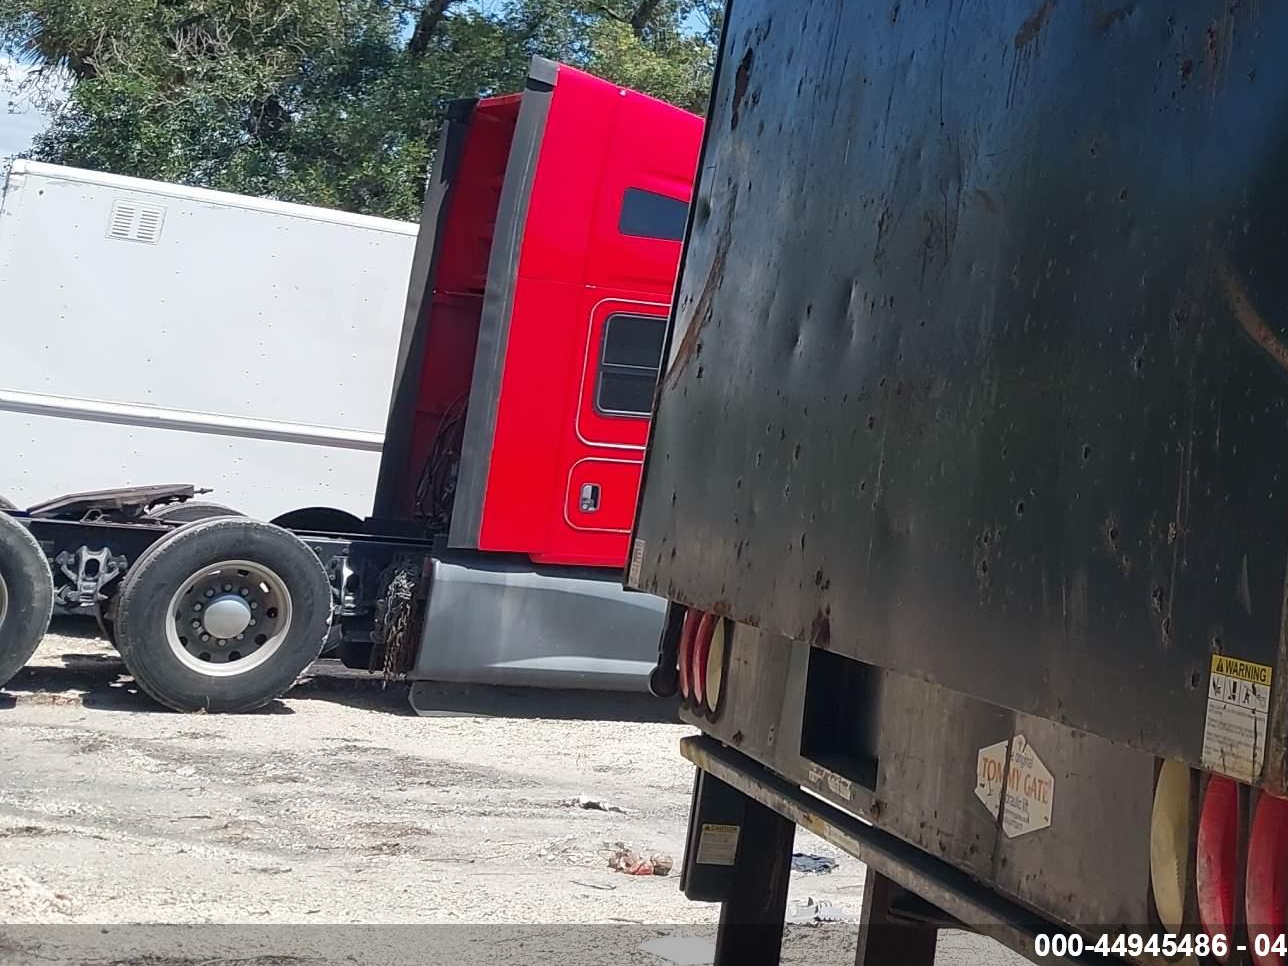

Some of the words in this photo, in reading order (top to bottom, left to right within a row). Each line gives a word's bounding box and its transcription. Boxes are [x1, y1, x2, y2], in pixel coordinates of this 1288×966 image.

[1225, 661, 1267, 682] WARNING
[983, 757, 1022, 792] TOMMY
[1024, 774, 1049, 804] GATE
